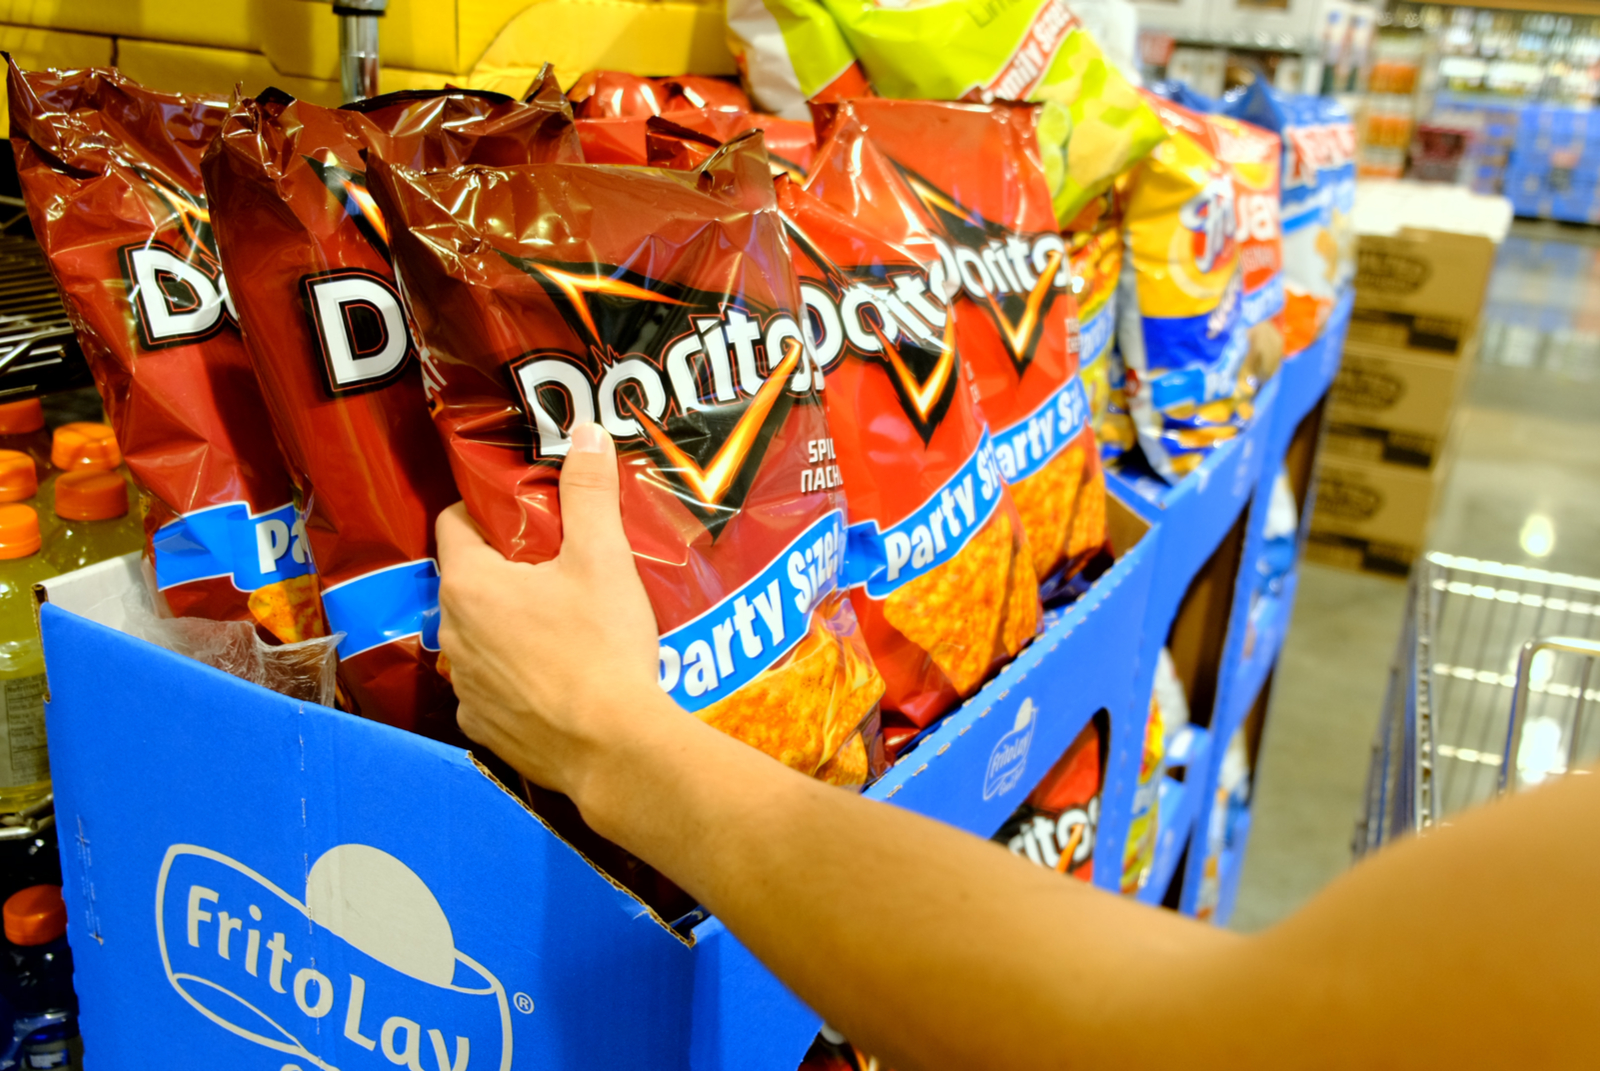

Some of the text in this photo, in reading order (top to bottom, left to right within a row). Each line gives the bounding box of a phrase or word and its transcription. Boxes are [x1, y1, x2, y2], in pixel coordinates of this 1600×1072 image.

[132, 249, 240, 338] D
[801, 465, 844, 493] NACH
[995, 408, 1054, 480] arty
